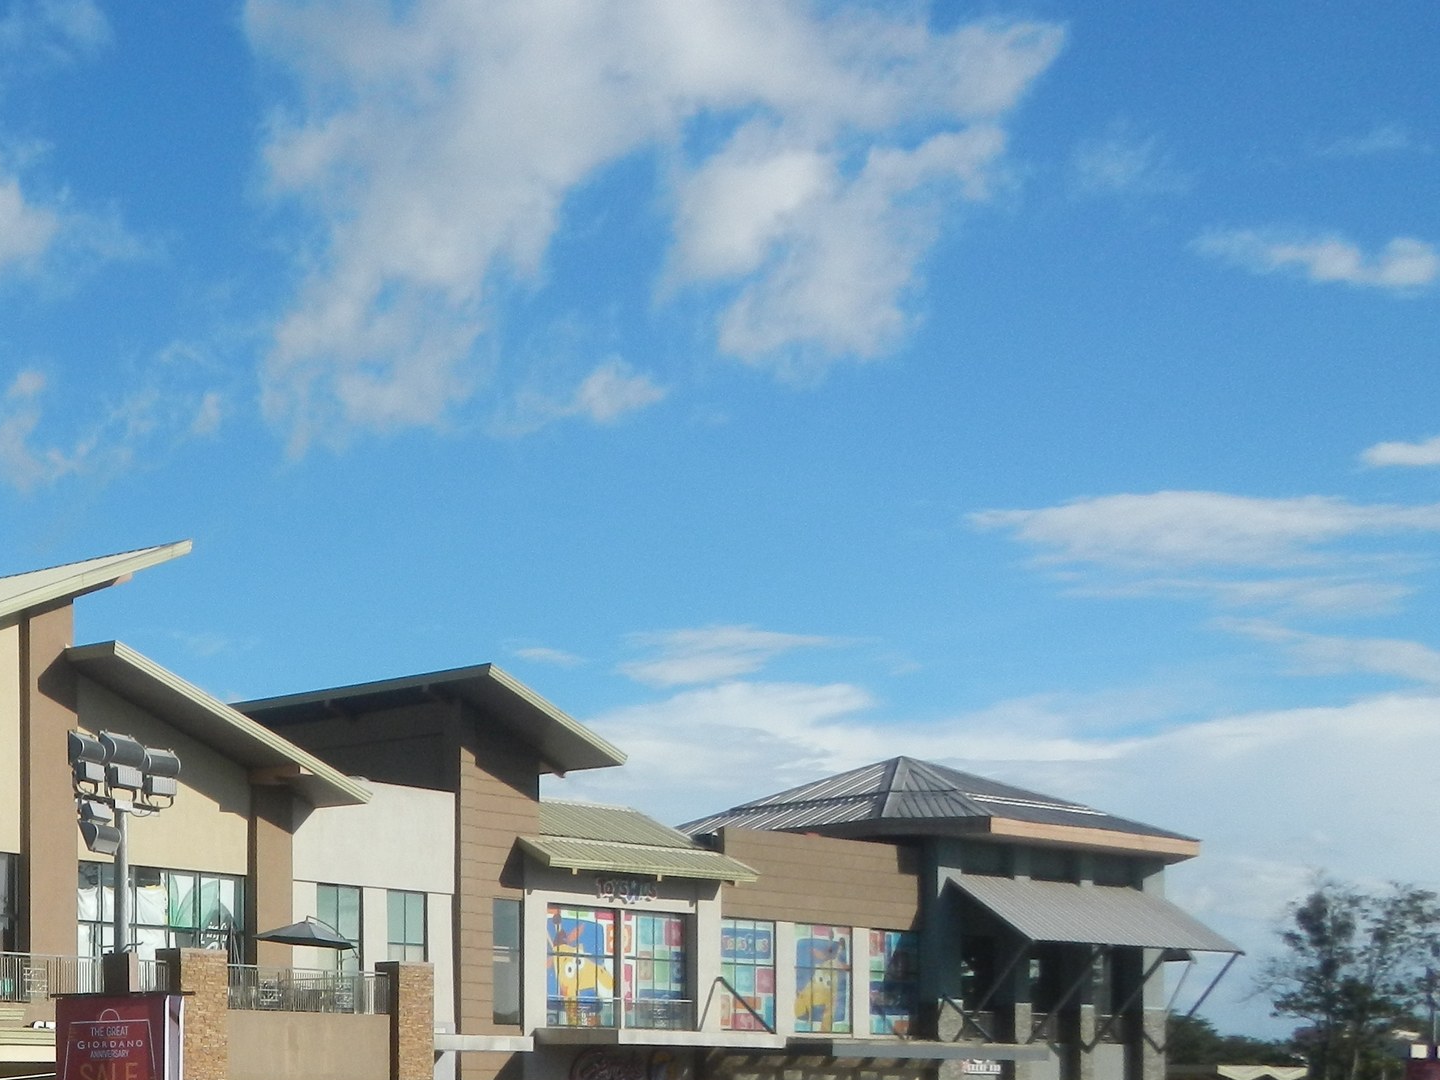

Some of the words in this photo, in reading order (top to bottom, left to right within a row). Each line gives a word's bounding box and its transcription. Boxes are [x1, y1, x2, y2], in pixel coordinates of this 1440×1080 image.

[90, 1026, 104, 1037] THE
[106, 1025, 129, 1037] GREAT
[77, 1040, 143, 1050] GIORDANO
